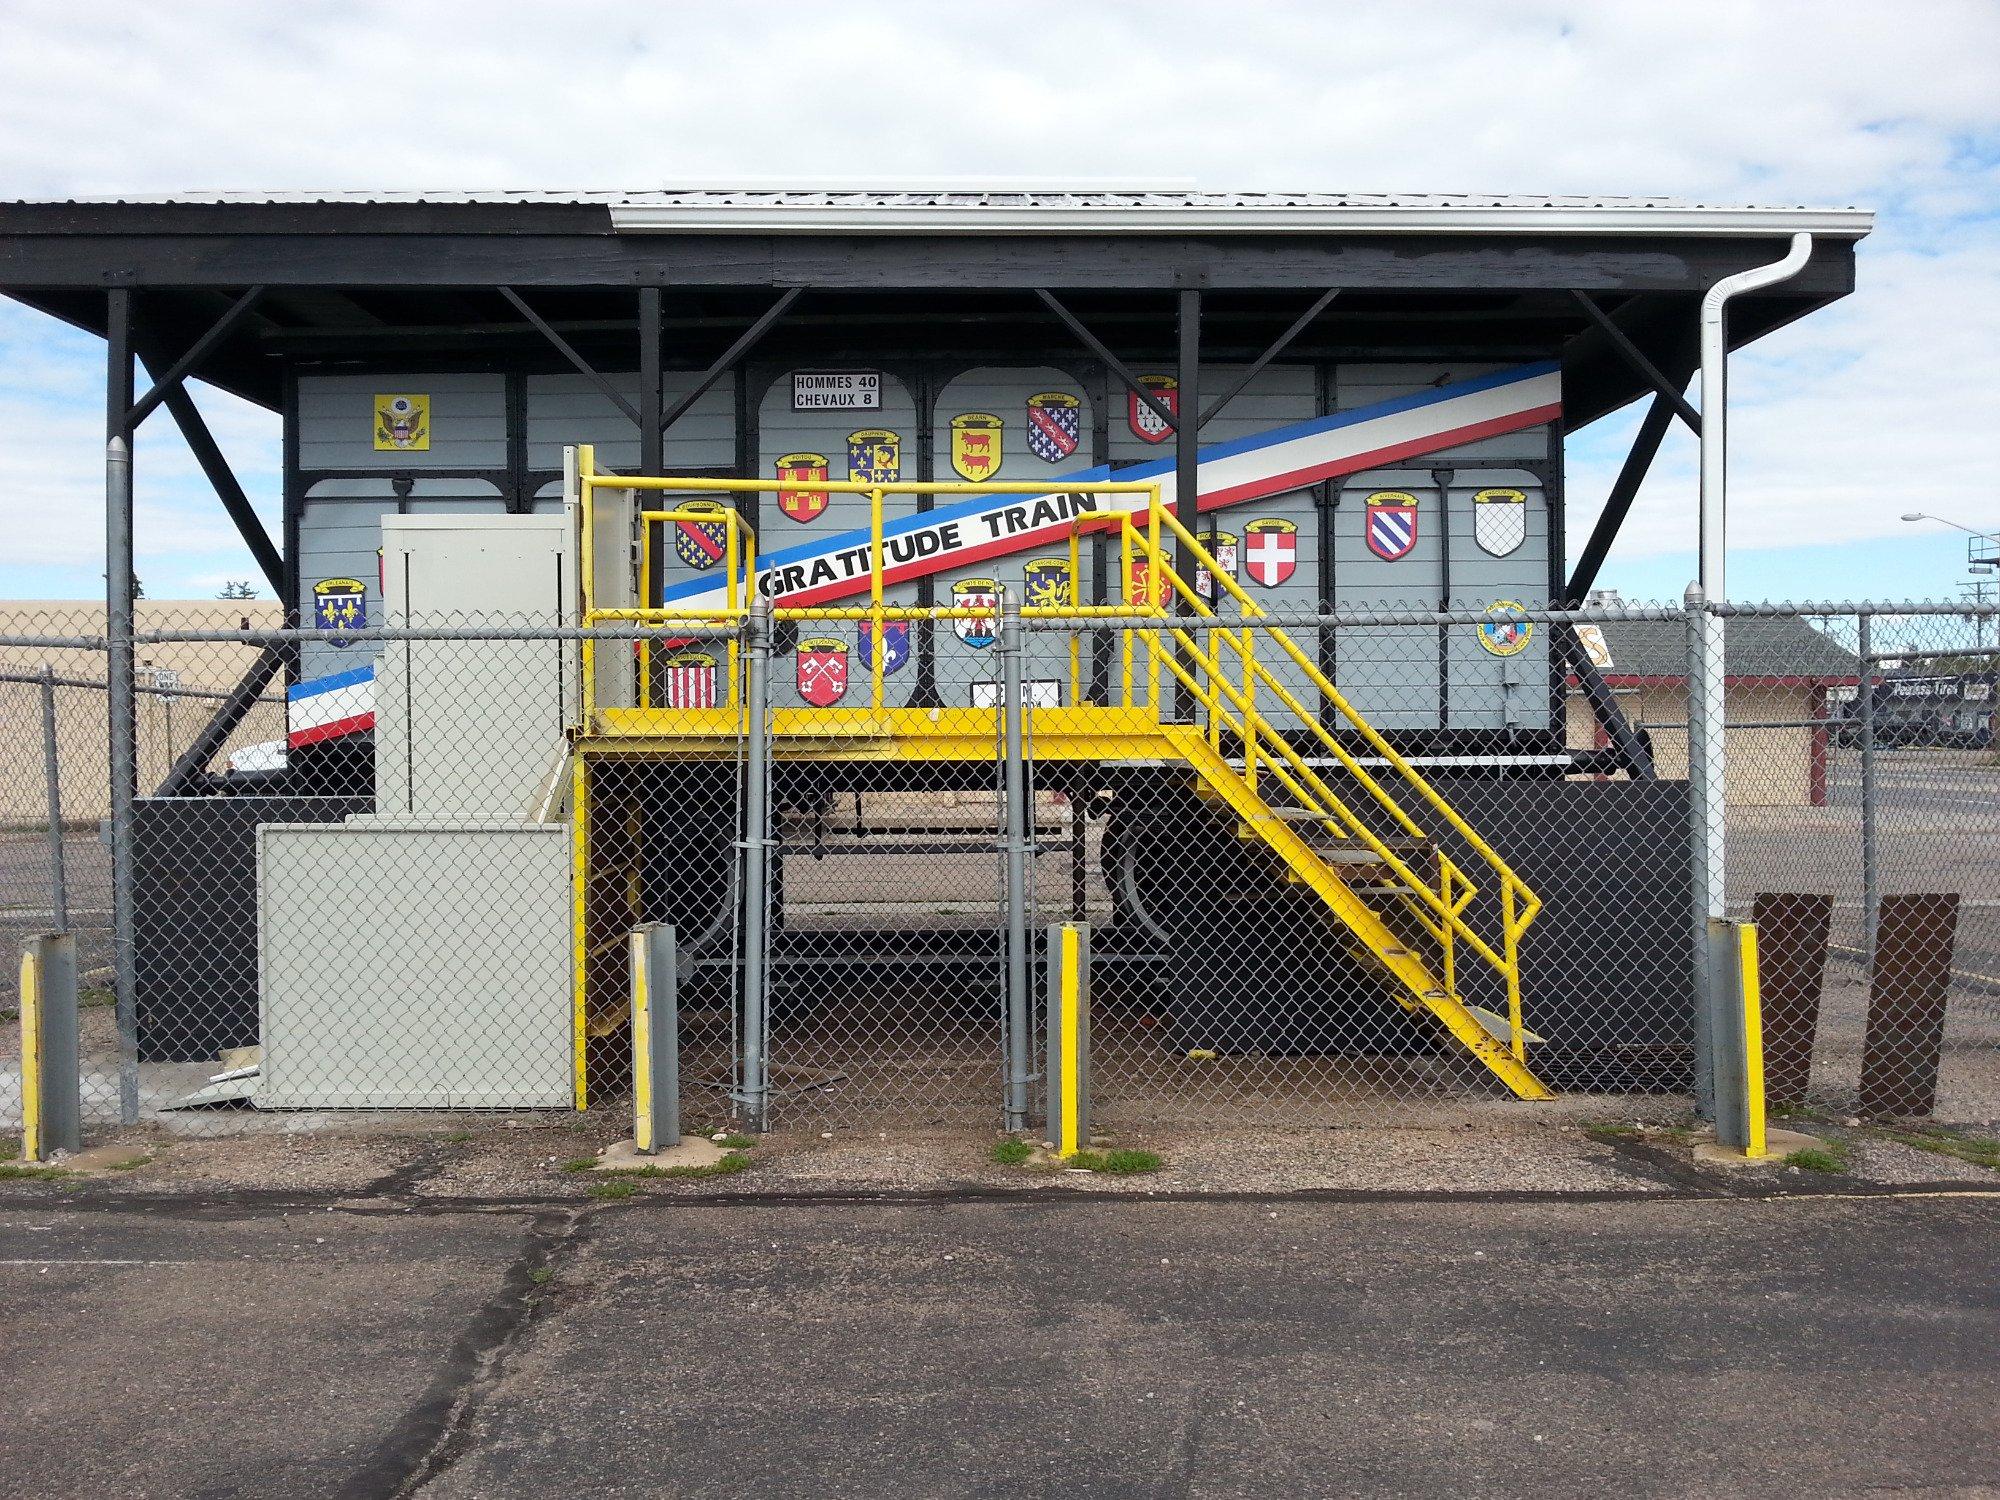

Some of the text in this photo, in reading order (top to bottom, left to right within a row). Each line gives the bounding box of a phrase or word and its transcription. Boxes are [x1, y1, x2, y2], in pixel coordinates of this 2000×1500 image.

[796, 376, 877, 389] HOMMES 40
[796, 393, 872, 406] CHEVAUX 8
[981, 492, 1098, 538] TRAIN
